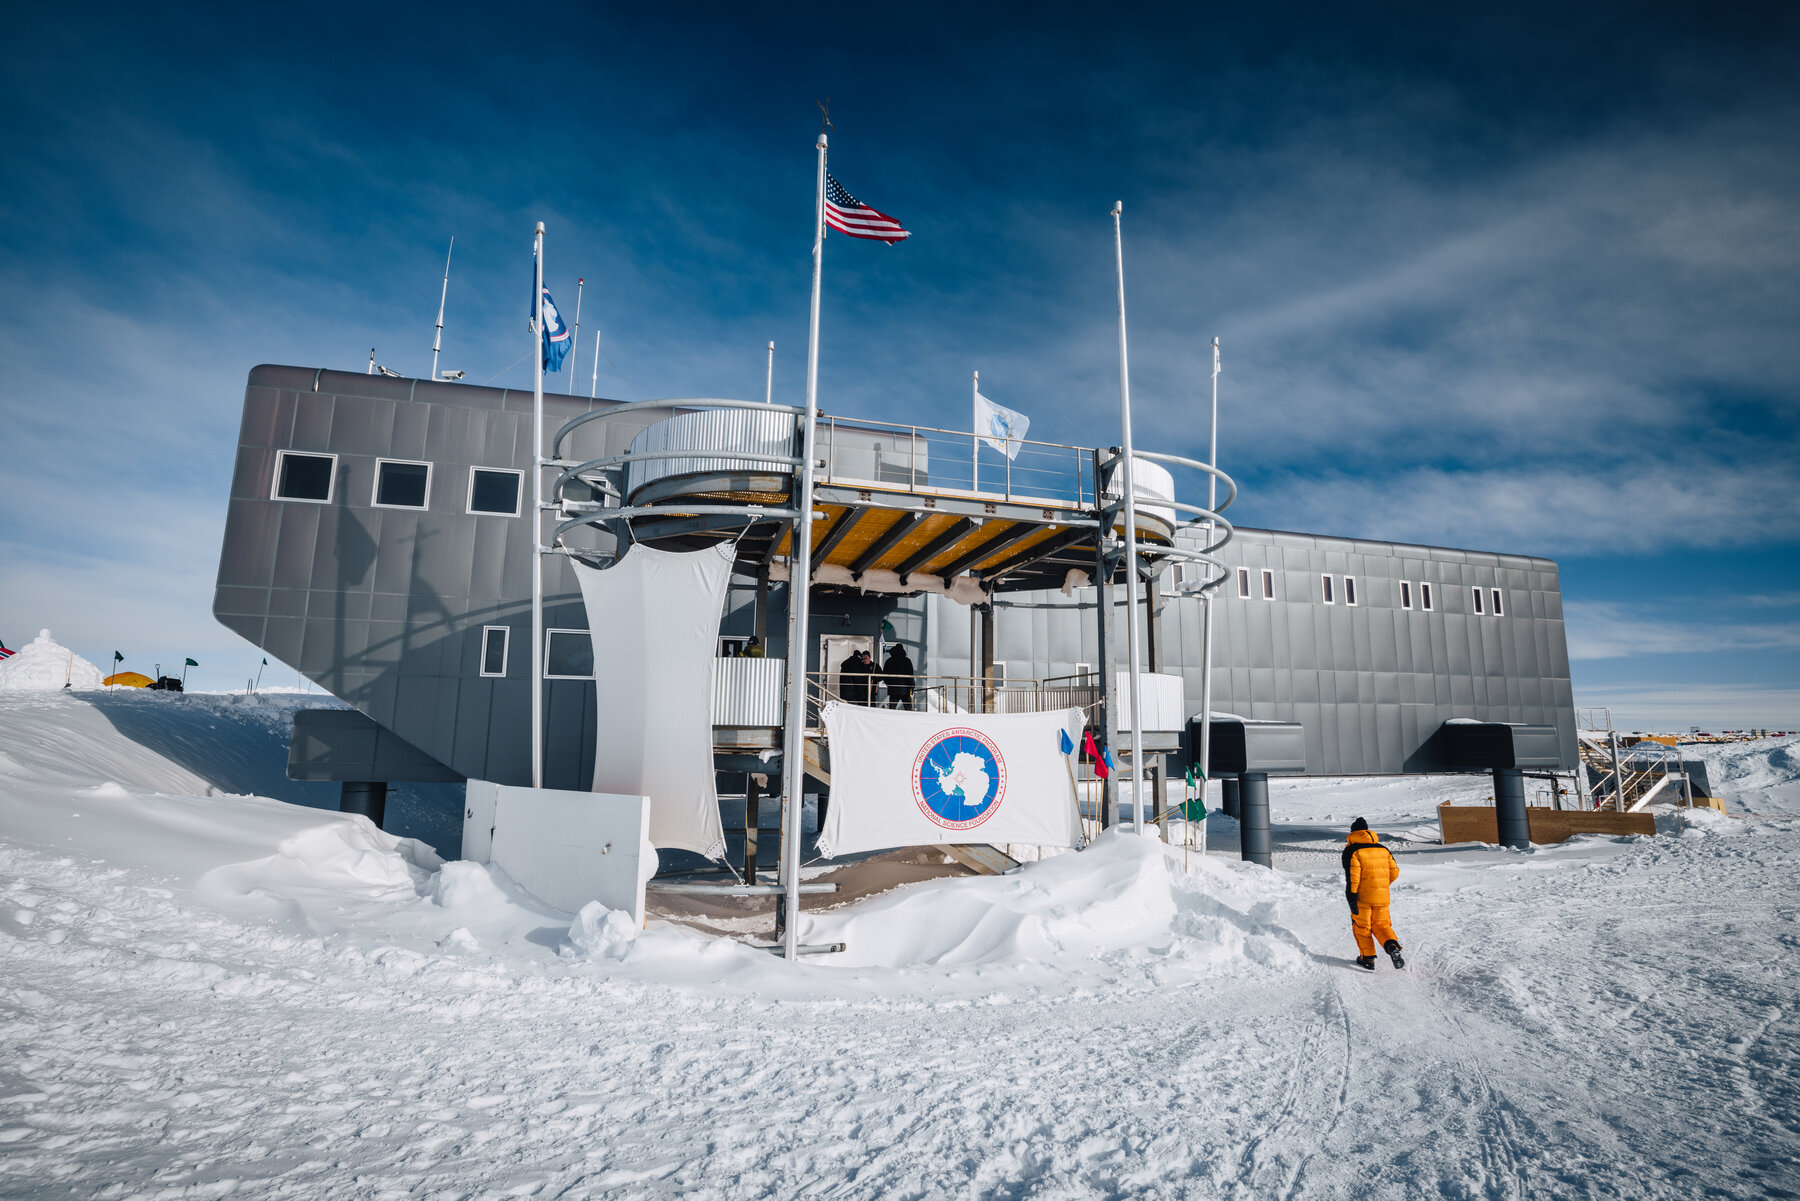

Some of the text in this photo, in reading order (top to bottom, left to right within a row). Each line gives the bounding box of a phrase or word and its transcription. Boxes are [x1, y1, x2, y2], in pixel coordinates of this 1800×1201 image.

[917, 729, 1002, 763] UNITED STATES ANTARCTIC PROGRAM
[919, 800, 999, 828] NATIONAL SCIENCE FOUNDATION
